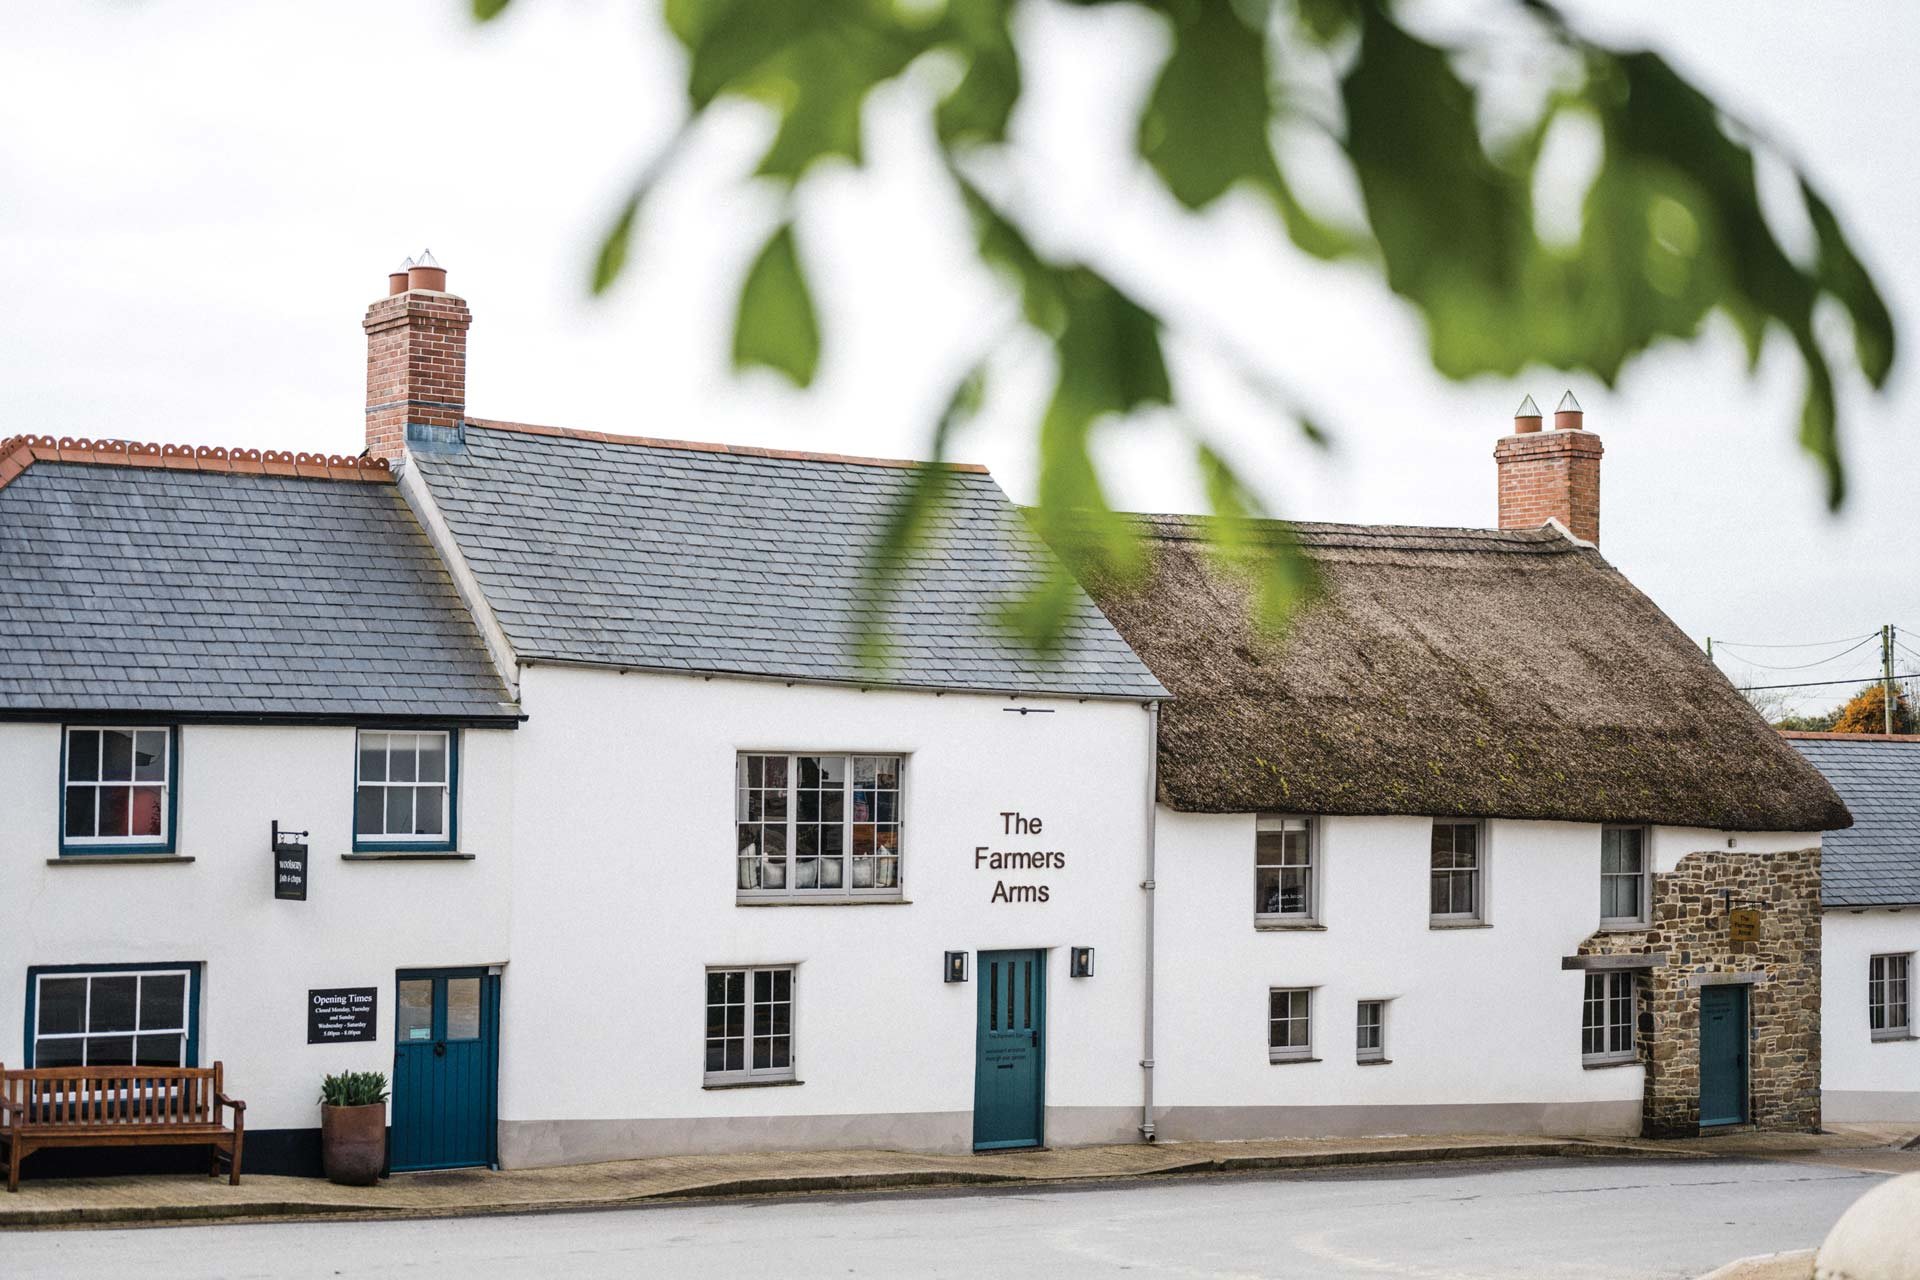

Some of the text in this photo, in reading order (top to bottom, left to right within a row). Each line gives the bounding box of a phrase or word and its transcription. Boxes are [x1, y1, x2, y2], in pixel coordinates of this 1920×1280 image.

[1000, 812, 1042, 834] The
[975, 846, 1065, 869] Farmers
[991, 880, 1049, 903] Arms
[313, 994, 372, 1006] Opening Times
